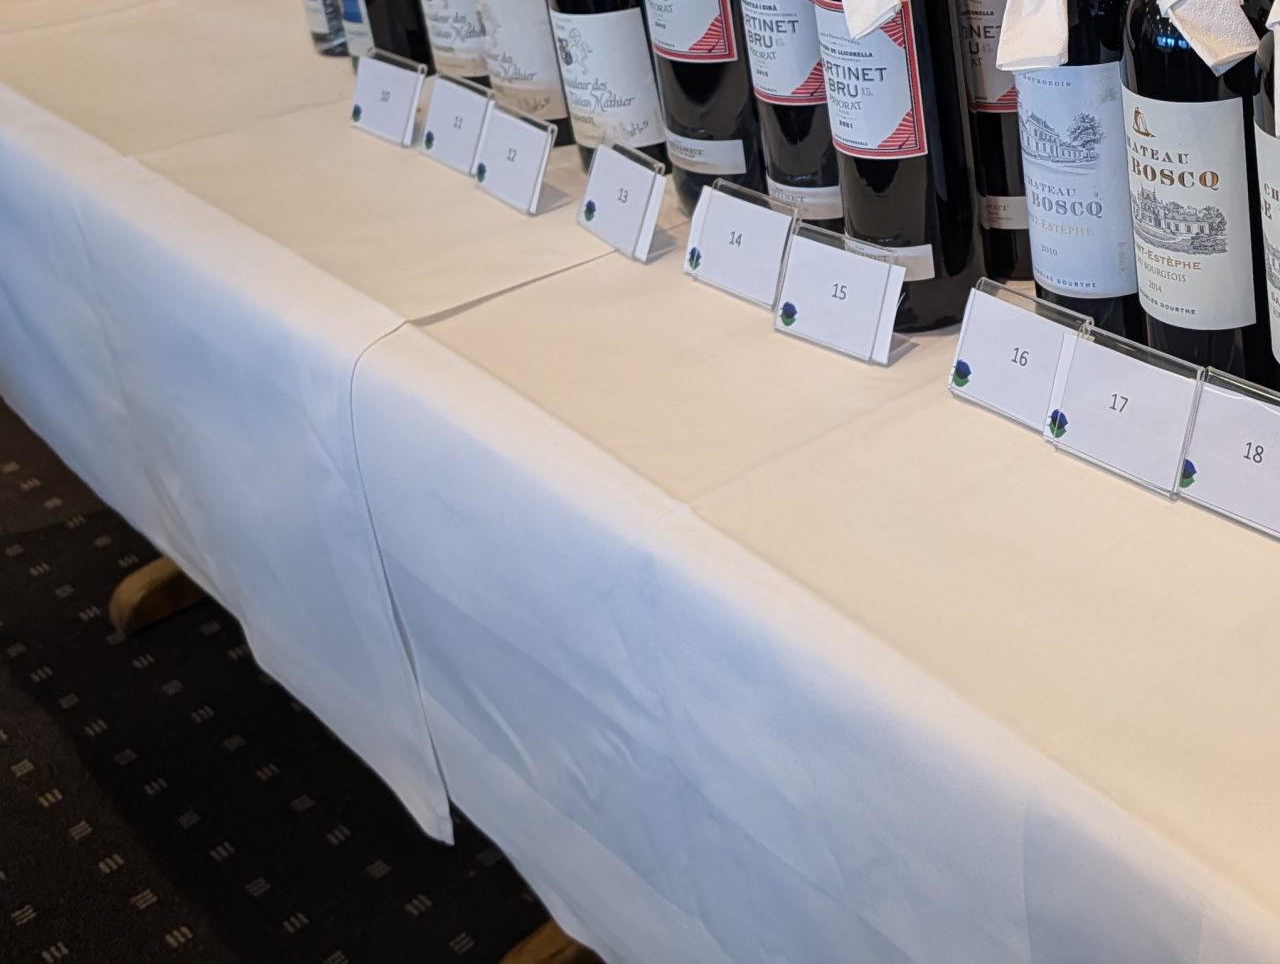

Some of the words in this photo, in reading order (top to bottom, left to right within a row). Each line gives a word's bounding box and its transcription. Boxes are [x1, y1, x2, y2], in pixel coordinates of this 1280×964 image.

[745, 13, 799, 34] RTINET
[747, 30, 774, 48] BRU
[828, 77, 859, 98] BRU
[829, 94, 862, 110] PRIORAT
[506, 148, 517, 162] 12
[1131, 156, 1219, 191] BOSCQ
[618, 188, 629, 203] 13
[1031, 190, 1103, 219] BOSCQ
[729, 231, 742, 247] 14
[832, 283, 847, 300] 15
[1160, 302, 1196, 315] DOURTHE
[1011, 346, 1029, 367] 16
[1109, 393, 1128, 413] 17
[1243, 441, 1264, 463] 18
